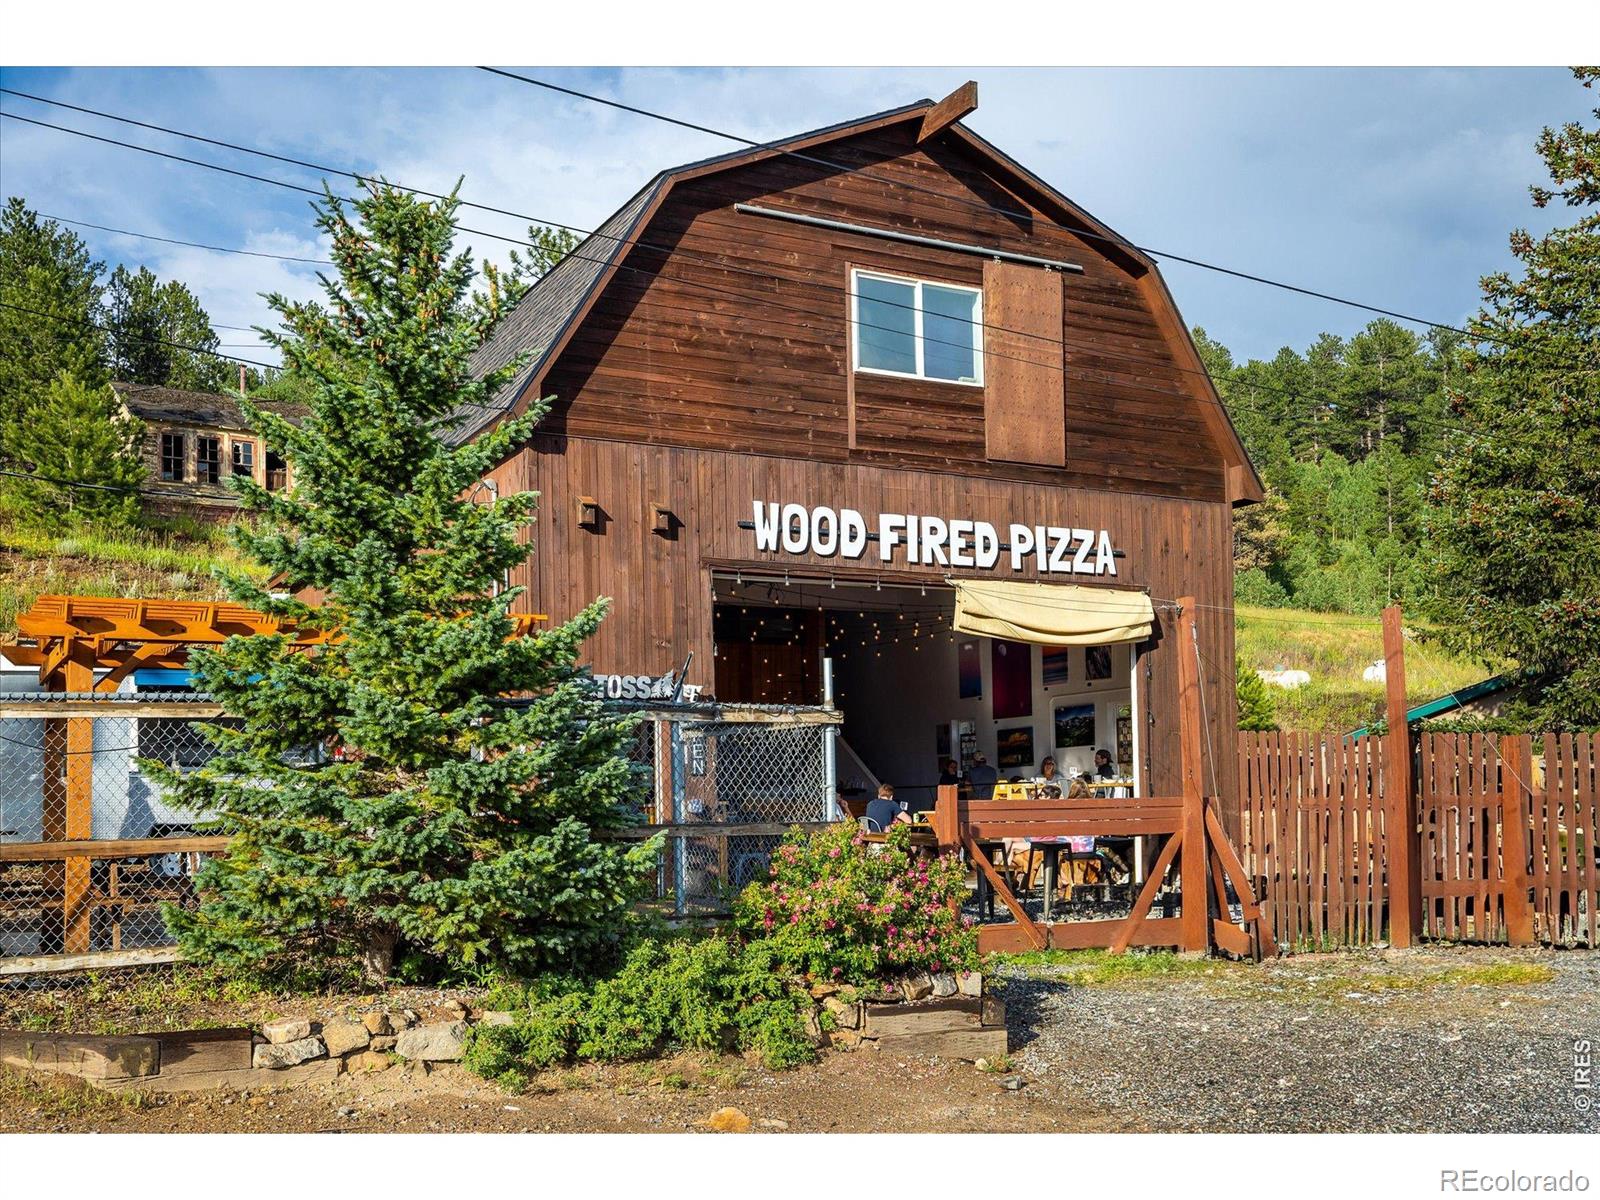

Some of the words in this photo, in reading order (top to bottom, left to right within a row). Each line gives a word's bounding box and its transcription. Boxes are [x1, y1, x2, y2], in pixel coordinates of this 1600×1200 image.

[753, 500, 866, 557] WOOD
[878, 513, 999, 568] FIRED
[1009, 523, 1117, 576] PIZZA
[594, 674, 651, 699] TOSS
[692, 737, 704, 774] EN
